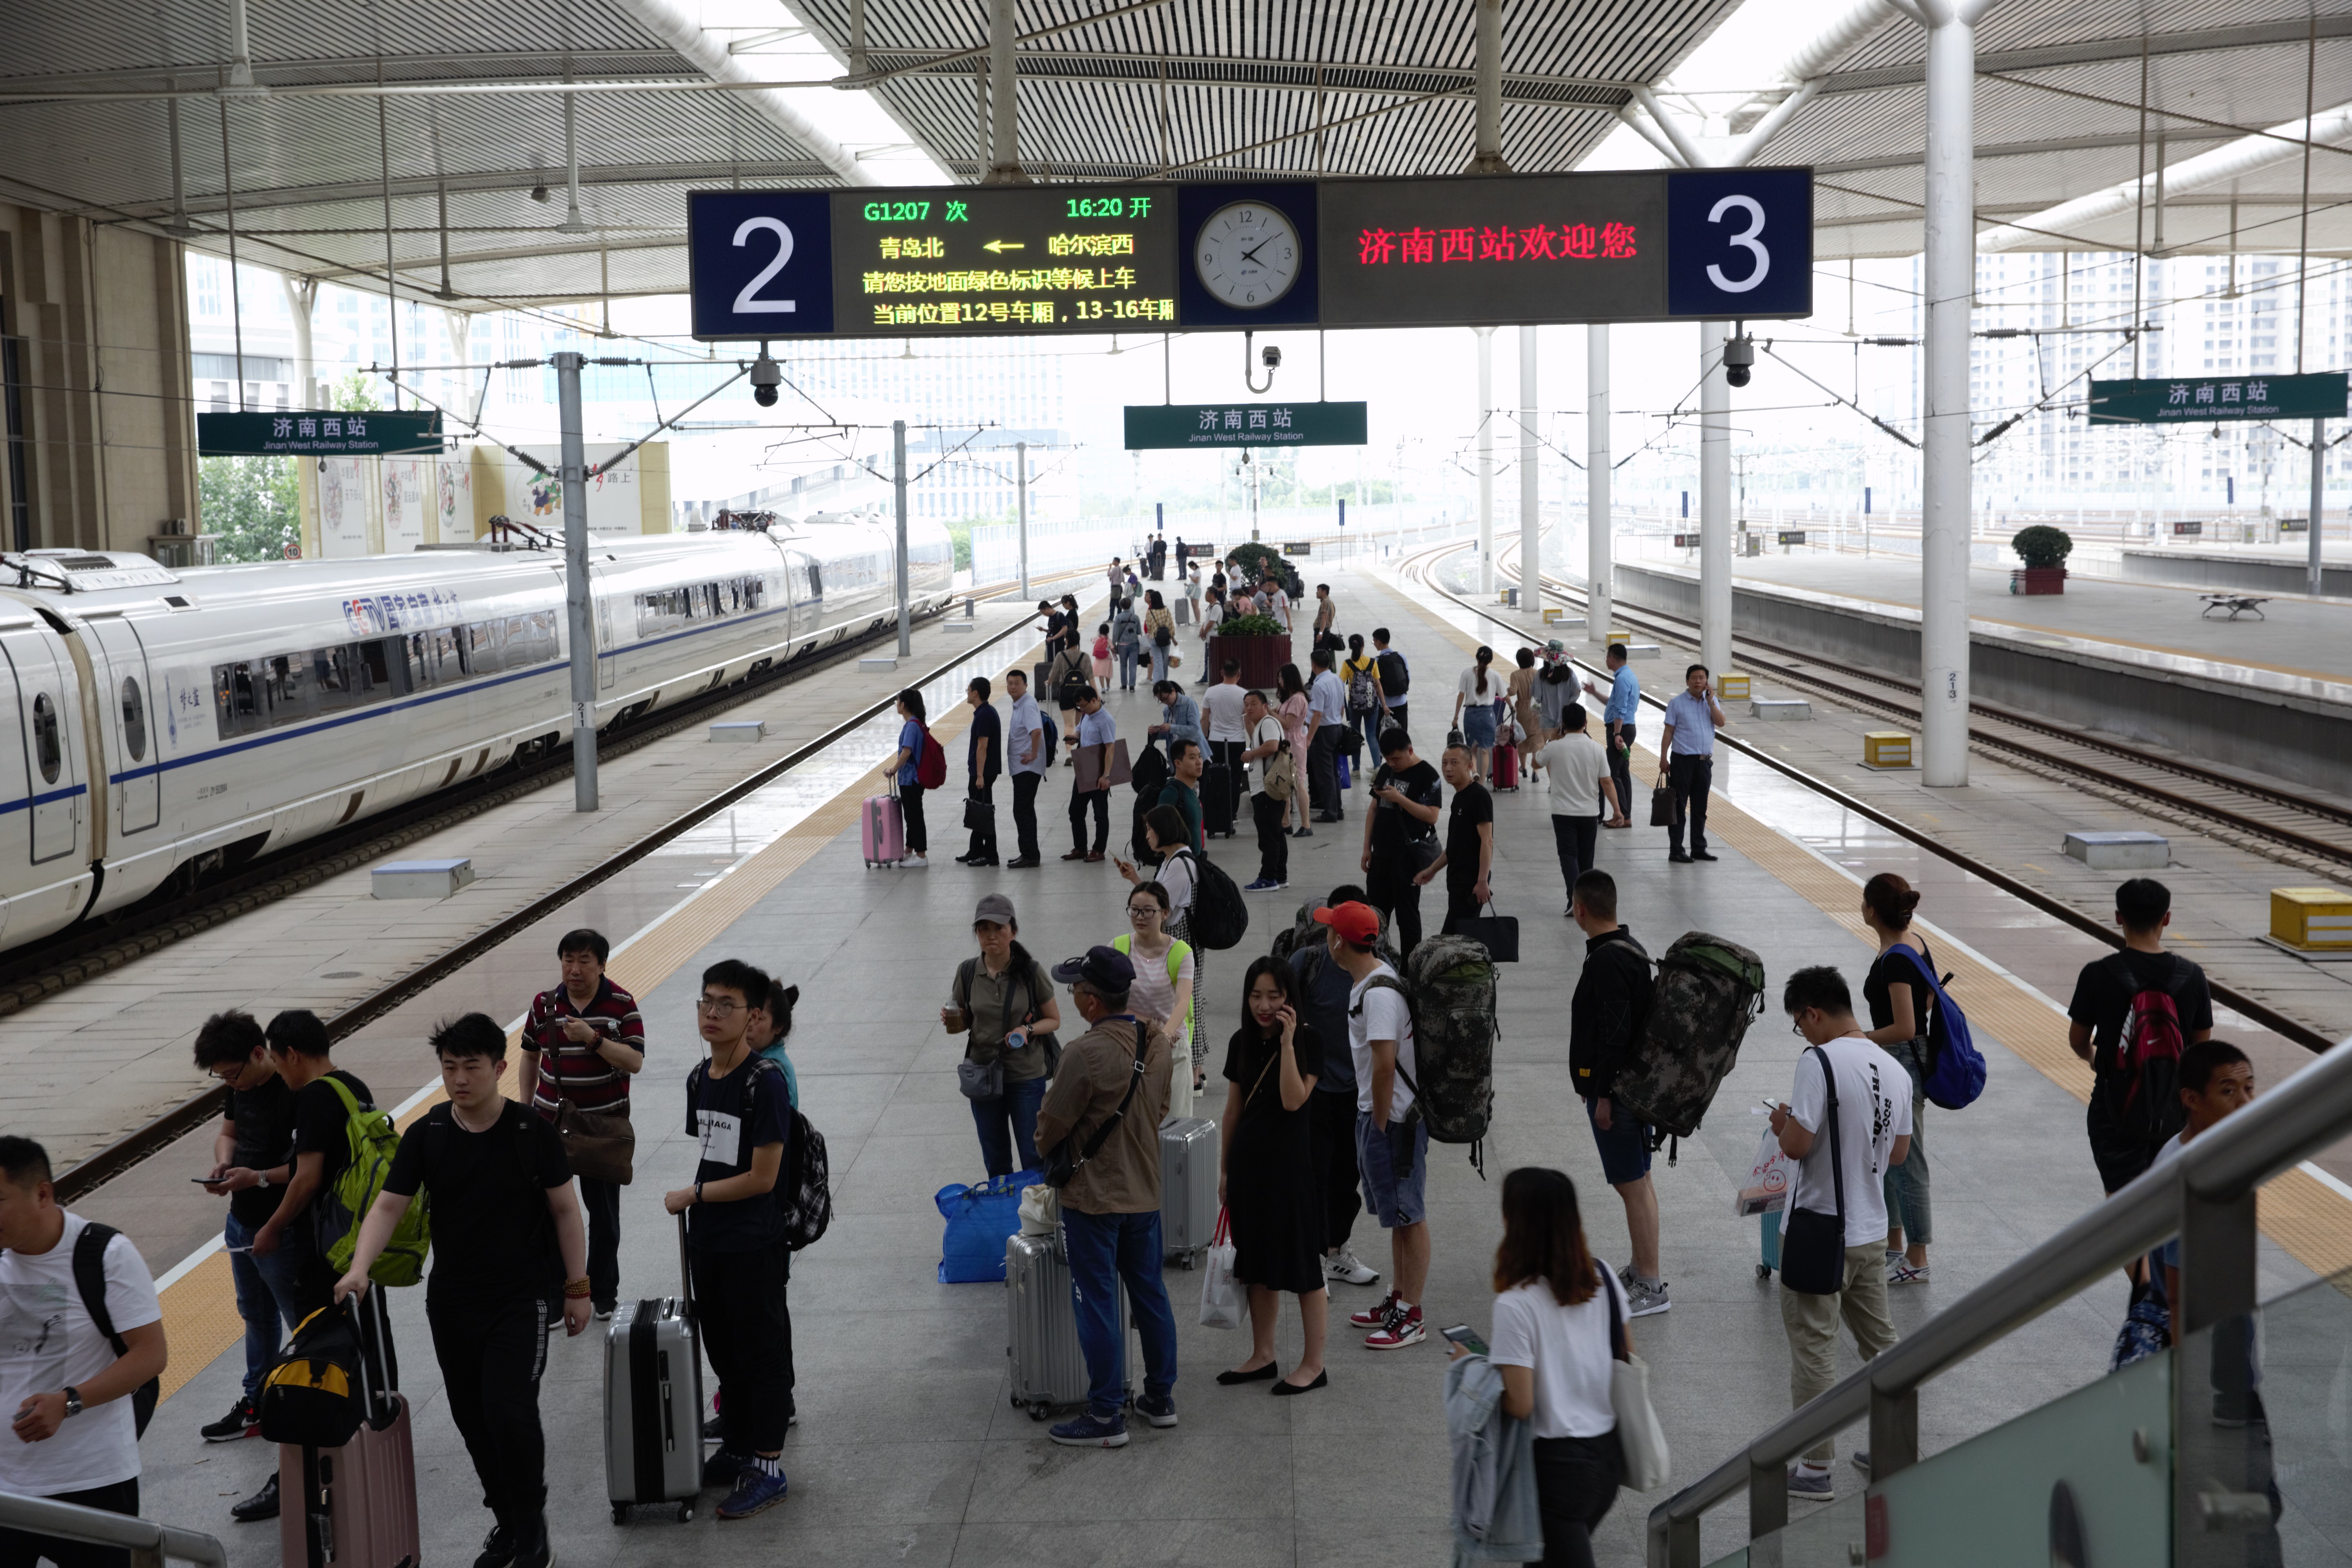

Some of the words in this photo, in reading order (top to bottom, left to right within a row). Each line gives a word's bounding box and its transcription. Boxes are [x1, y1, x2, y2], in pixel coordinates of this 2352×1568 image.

[864, 202, 930, 221] G1207
[946, 200, 968, 222] 次
[1067, 198, 1123, 218] 16:20
[1129, 197, 1152, 218] 开
[1239, 211, 1252, 223] 12
[879, 237, 944, 258] 青岛北
[1049, 234, 1134, 256] 哈尔滨西
[1284, 248, 1292, 259] 3
[1359, 222, 1637, 264] 济南西站欢迎您
[1706, 195, 1770, 293] 3
[733, 217, 796, 313] 2
[1205, 254, 1212, 266] 9
[863, 267, 1136, 294] 请您按地面绿色标识等候上车
[1247, 291, 1254, 302] 6
[2169, 381, 2268, 404] 济南西站
[1199, 408, 1292, 430] 济南西站
[2157, 408, 2182, 417] Jinan
[2209, 406, 2245, 416] Railway
[2247, 405, 2279, 414] Station
[273, 416, 367, 437] 济南西站
[1238, 433, 1272, 441] Railway
[1274, 432, 1303, 440] Station
[313, 441, 346, 450] Railway
[287, 548, 298, 556] 10
